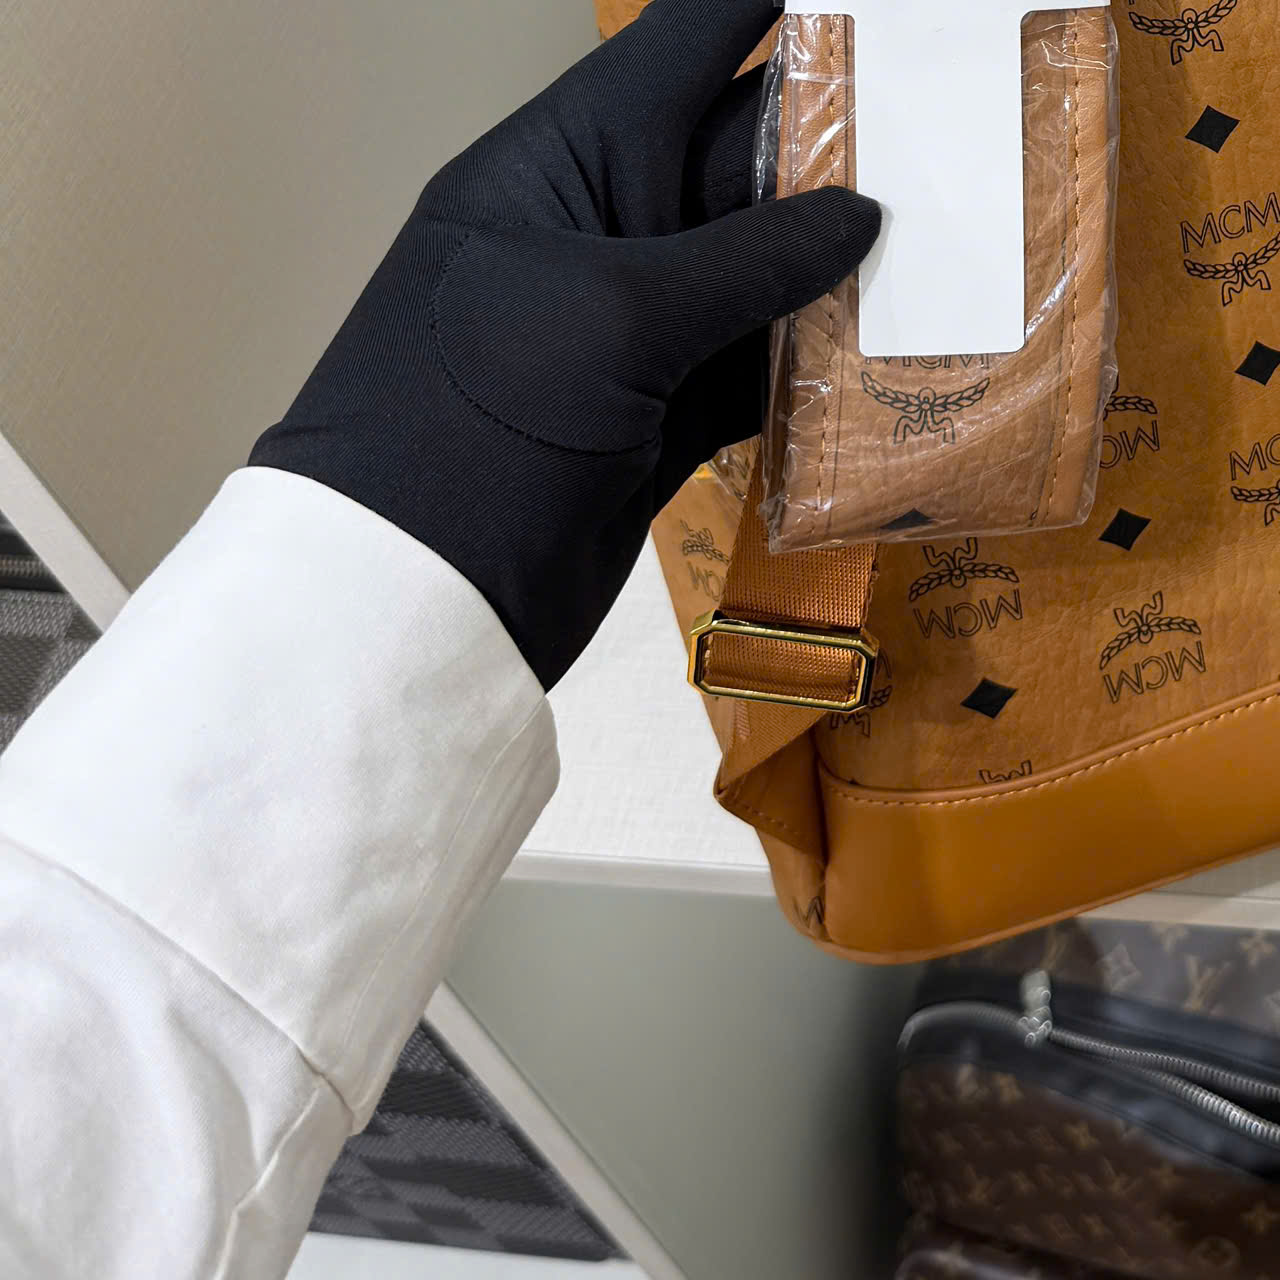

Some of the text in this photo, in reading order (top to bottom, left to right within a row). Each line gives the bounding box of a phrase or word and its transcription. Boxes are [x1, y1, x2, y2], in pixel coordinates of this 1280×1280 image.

[1099, 419, 1162, 470] MC
[912, 586, 1025, 641] MCM
[1103, 641, 1208, 705] MCM
